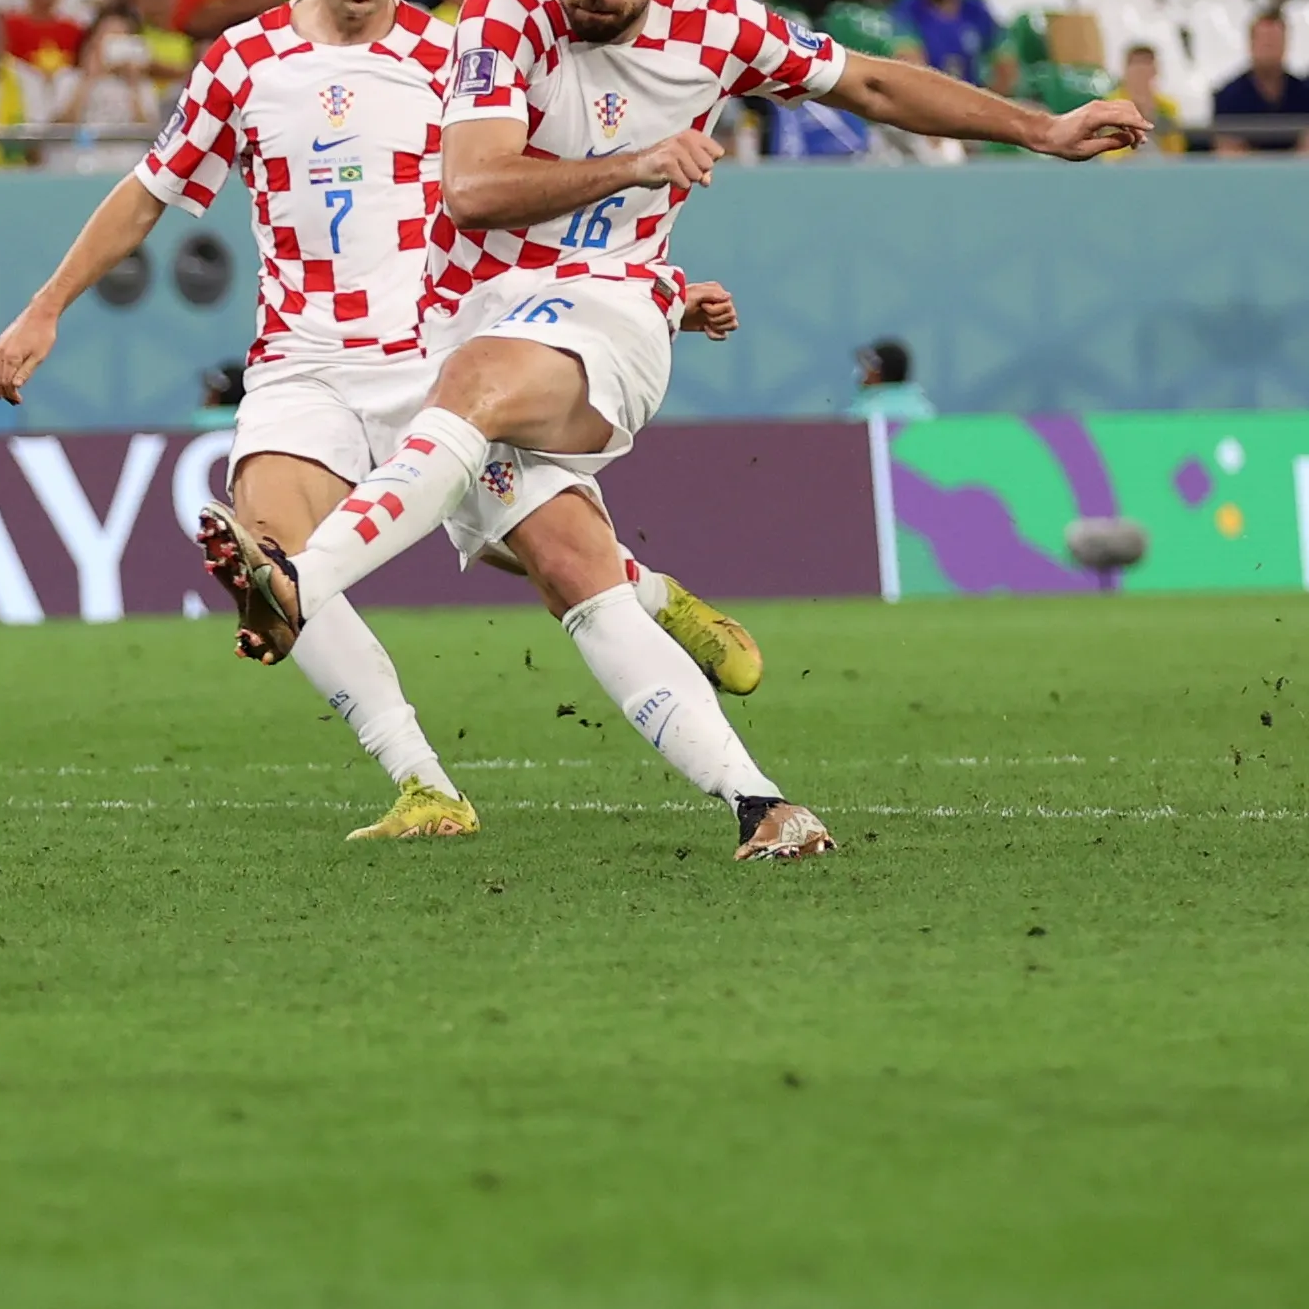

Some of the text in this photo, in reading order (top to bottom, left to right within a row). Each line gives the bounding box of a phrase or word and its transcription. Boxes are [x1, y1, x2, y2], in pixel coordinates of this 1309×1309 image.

[324, 189, 354, 254] 7
[559, 196, 626, 250] 16
[492, 294, 575, 328] 16
